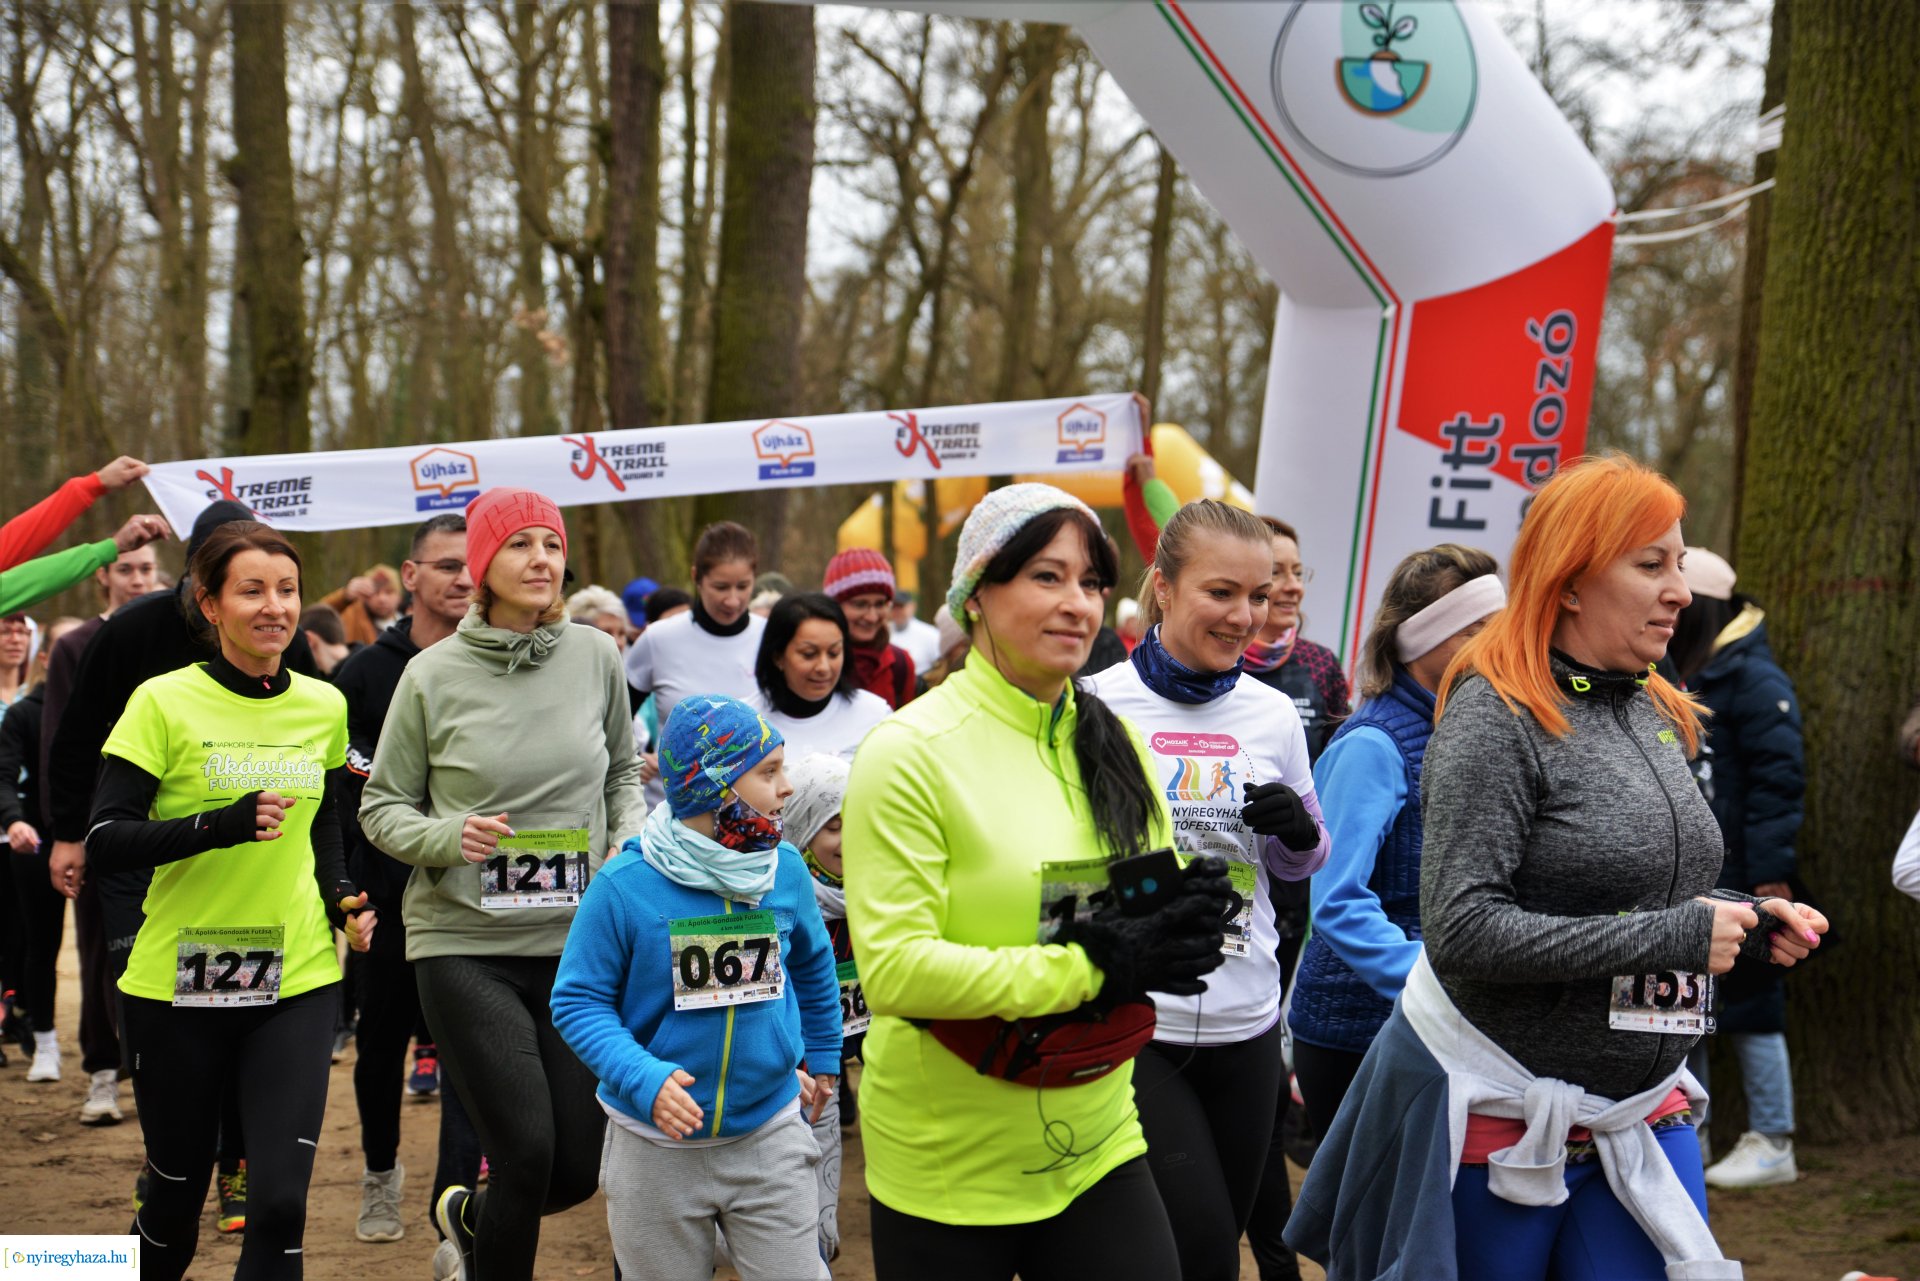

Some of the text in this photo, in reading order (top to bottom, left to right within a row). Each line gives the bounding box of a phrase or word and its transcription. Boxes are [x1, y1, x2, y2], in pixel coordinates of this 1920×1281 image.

[1511, 308, 1577, 516] dozó
[561, 434, 666, 481] EXTREME
[934, 437, 981, 450] TRAIL
[613, 455, 669, 471] TRAIL
[1429, 412, 1504, 530] Fitt
[250, 493, 313, 511] TRAIL
[214, 741, 246, 749] NAPKORI
[246, 741, 255, 749] SE
[200, 752, 322, 781] Akácvirág
[487, 853, 566, 891] 121
[195, 928, 250, 936] Ápolók-Gondozók
[184, 950, 274, 990] 127
[679, 937, 771, 989] 067
